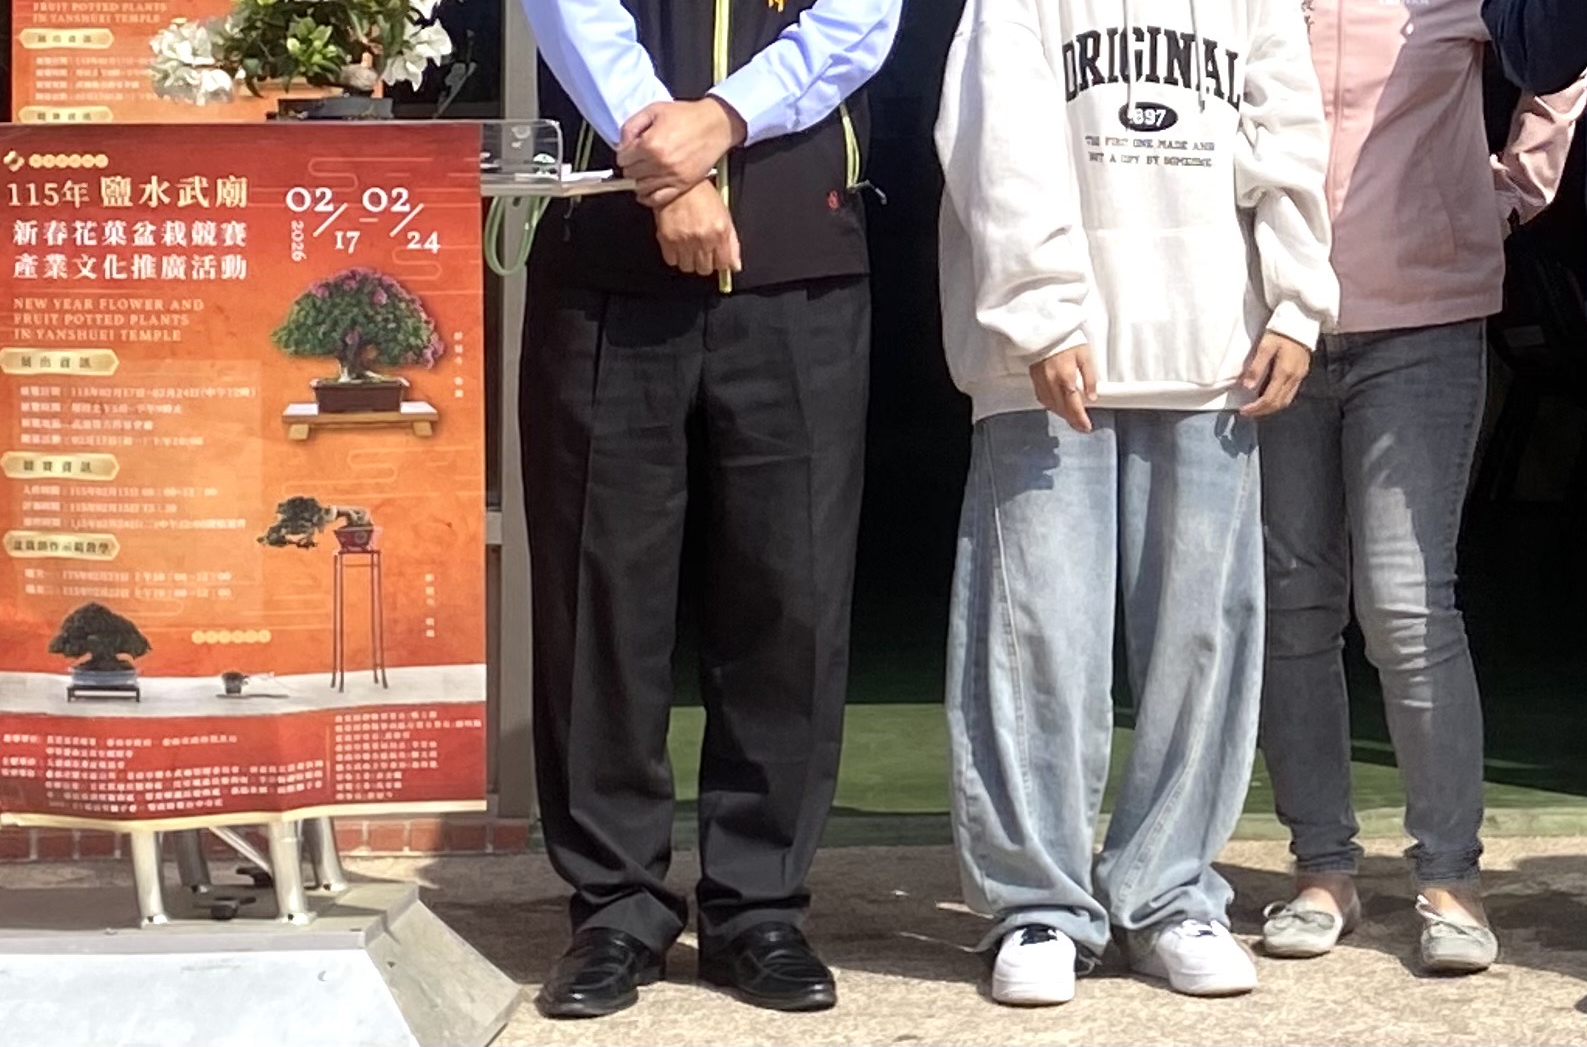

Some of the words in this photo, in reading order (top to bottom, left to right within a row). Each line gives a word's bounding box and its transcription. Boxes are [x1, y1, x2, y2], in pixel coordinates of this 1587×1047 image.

[1062, 25, 1242, 113] ORIGINAL
[7, 181, 91, 209] 115年
[100, 175, 249, 209] 鹽水武廟
[13, 219, 248, 248] 新春花菓盆栽競賽
[290, 220, 307, 261] 2026
[12, 253, 248, 281] 產業文化推廣活動
[13, 298, 47, 312] NEW
[54, 298, 93, 312] YEAR
[100, 298, 164, 312] FLOWER
[170, 298, 205, 312] AND
[13, 313, 59, 326] FRUIT
[64, 313, 124, 326] POTTED
[130, 313, 190, 326] PLANTS
[13, 328, 31, 341] IN
[37, 328, 114, 341] YANSHUEI
[120, 328, 182, 341] TEMPLE
